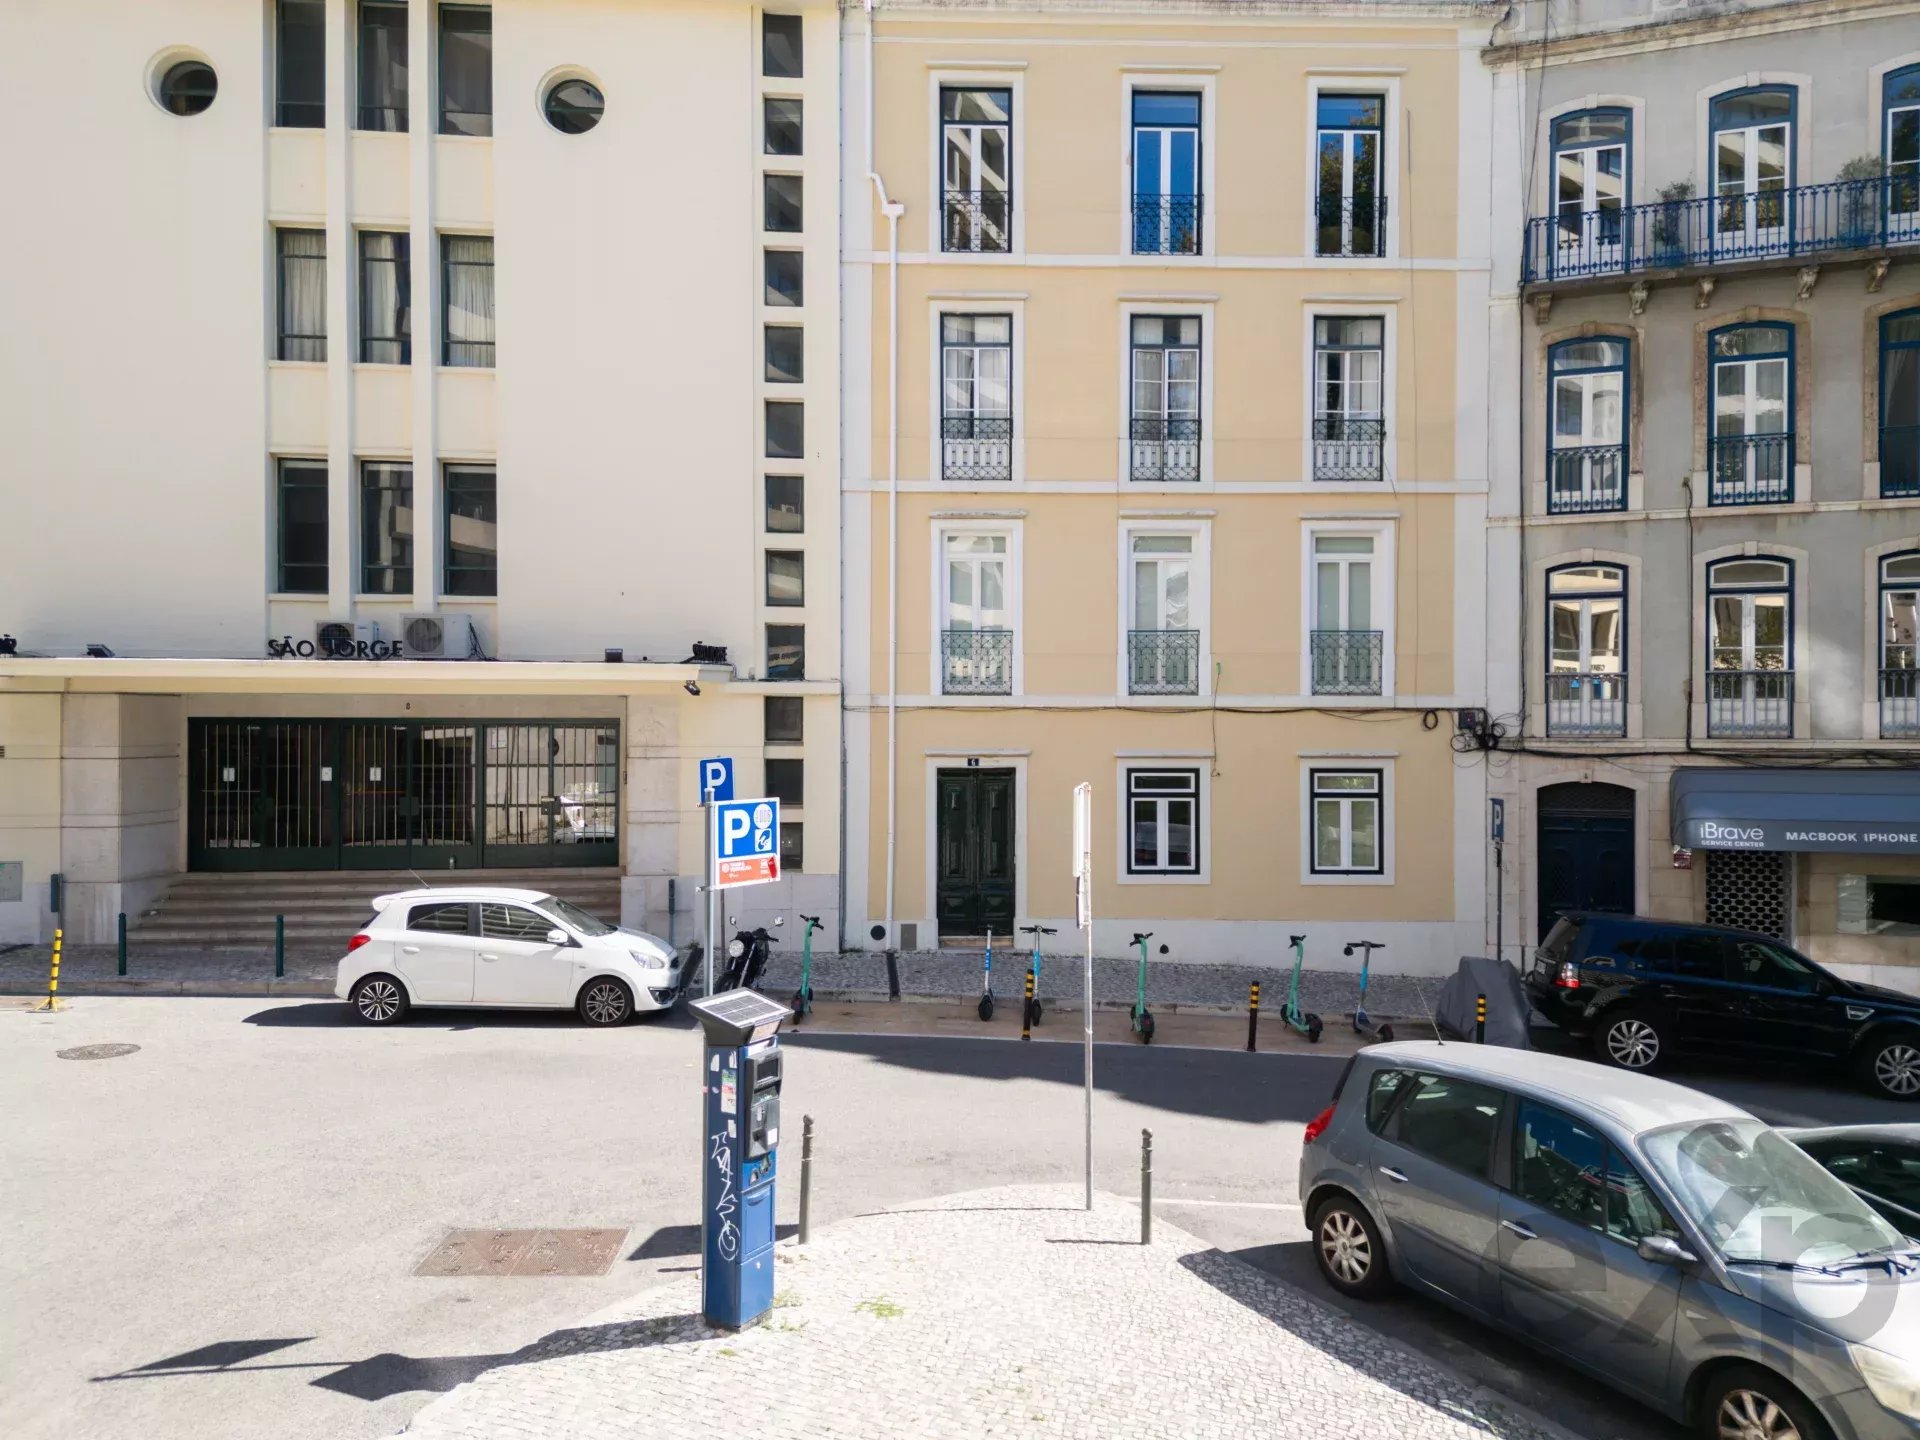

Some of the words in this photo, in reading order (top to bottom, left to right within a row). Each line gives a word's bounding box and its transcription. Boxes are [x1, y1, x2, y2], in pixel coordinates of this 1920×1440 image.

[268, 636, 315, 657] SÃO
[326, 639, 403, 658] JORGE
[706, 762, 727, 788] P
[1494, 804, 1502, 835] P
[1700, 822, 1764, 840] iBrave
[723, 809, 751, 855] P
[1785, 831, 1858, 842] MACBOOK
